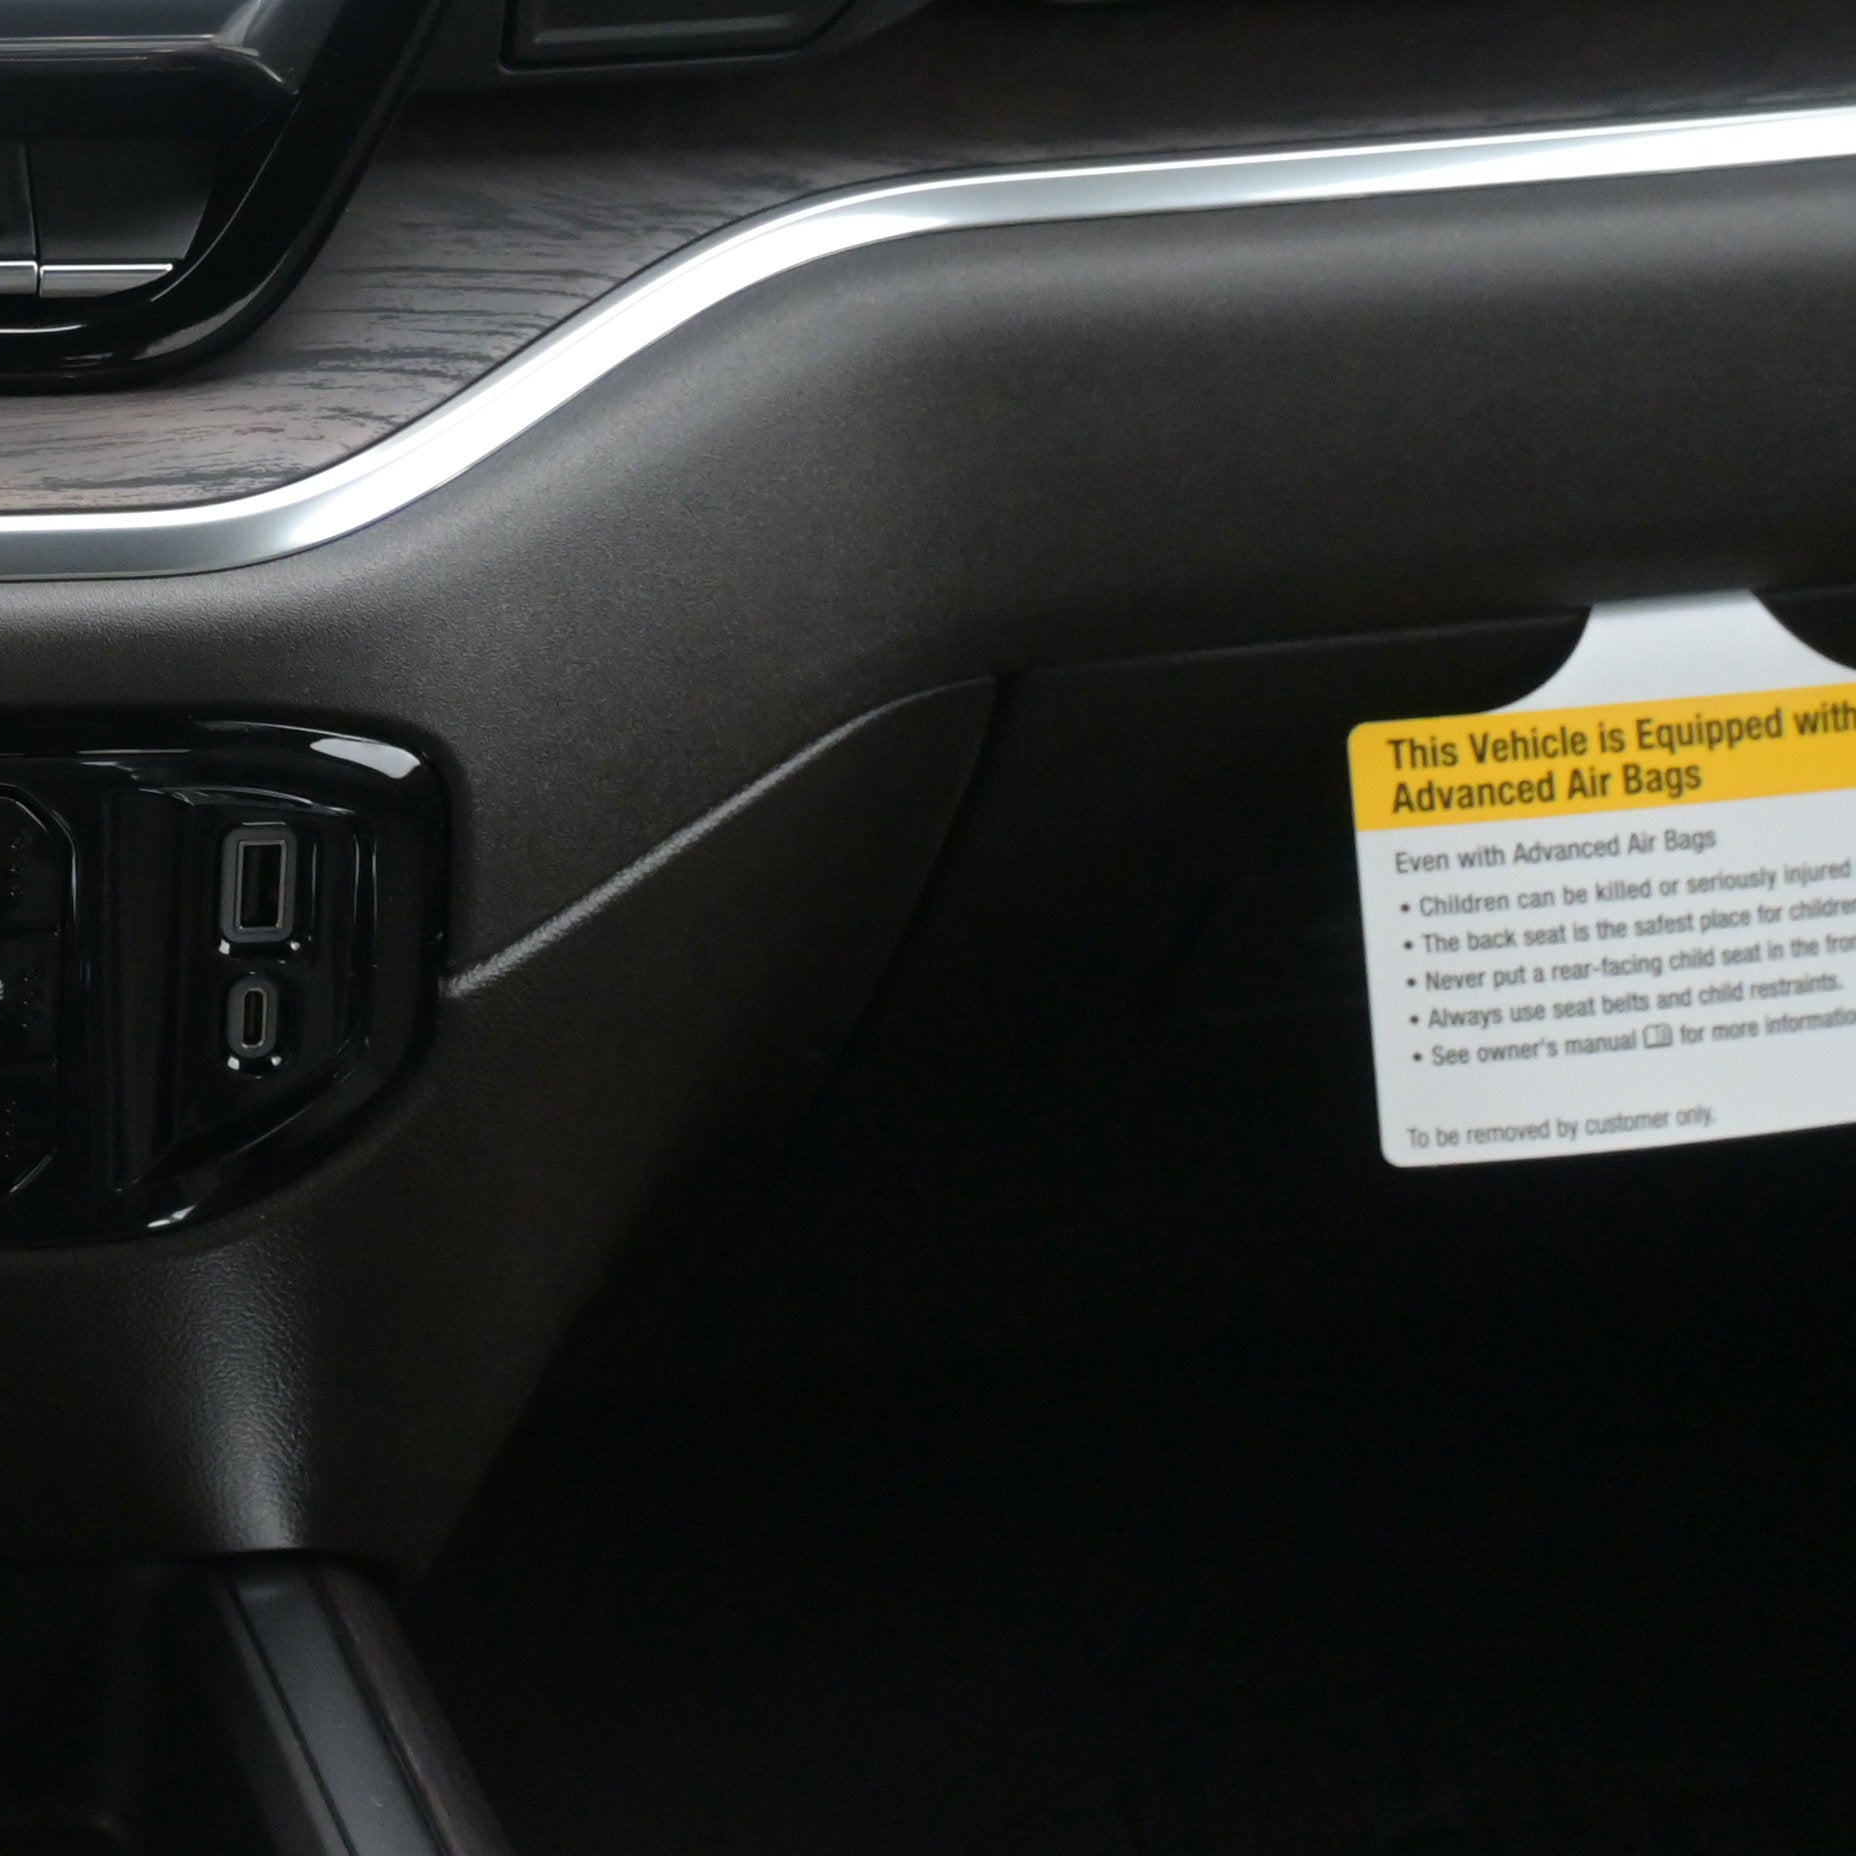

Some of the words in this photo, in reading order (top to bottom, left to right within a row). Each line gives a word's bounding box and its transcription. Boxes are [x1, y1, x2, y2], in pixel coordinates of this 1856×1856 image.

[1388, 736, 1458, 770] This
[1469, 726, 1588, 764] Vehicle
[1599, 722, 1626, 753] is
[1637, 707, 1783, 754] Equipped
[1793, 700, 1856, 735] with
[1393, 771, 1556, 813] Advanced
[1569, 767, 1611, 799] Air
[1623, 762, 1702, 799] Bags
[1395, 852, 1449, 874] Even
[1458, 845, 1505, 868] with
[1513, 836, 1620, 864] Advanced
[1628, 832, 1656, 854] Air
[1665, 829, 1716, 853] Bags
[1420, 893, 1510, 916] Children
[1518, 890, 1555, 908] can
[1563, 885, 1588, 904] be
[1596, 878, 1651, 902] killed
[1659, 879, 1678, 895] or
[1687, 867, 1776, 894] seriously
[1785, 859, 1851, 886] injured
[1423, 932, 1460, 952] The
[1468, 927, 1517, 950] back
[1524, 923, 1567, 944] seat
[1574, 921, 1590, 941] is
[1596, 918, 1628, 940] the
[1635, 914, 1693, 936] safest
[1701, 909, 1750, 933] place
[1758, 904, 1782, 924] for
[1789, 897, 1856, 921] childre
[1426, 969, 1486, 990] Never
[1493, 966, 1526, 991] put
[1534, 966, 1546, 982] a
[1552, 952, 1662, 980] rear-facing
[1670, 947, 1716, 970] child
[1722, 943, 1761, 966] seat
[1768, 940, 1784, 958] in
[1790, 938, 1820, 958] the
[1428, 1006, 1503, 1029] Always
[1510, 1005, 1546, 1023] use
[1553, 999, 1596, 1020] seat
[1602, 992, 1650, 1015] belts
[1656, 986, 1692, 1009] and
[1699, 981, 1744, 1006] child
[1431, 1044, 1470, 1067] See
[1477, 1038, 1558, 1062] owner's
[1564, 1030, 1637, 1056] manual
[1679, 1024, 1704, 1044] for
[1711, 1020, 1760, 1040] more
[1407, 1128, 1430, 1148] To
[1436, 1125, 1459, 1146] be
[1466, 1118, 1550, 1144] removed
[1556, 1117, 1578, 1140] by
[1584, 1110, 1670, 1135] customer
